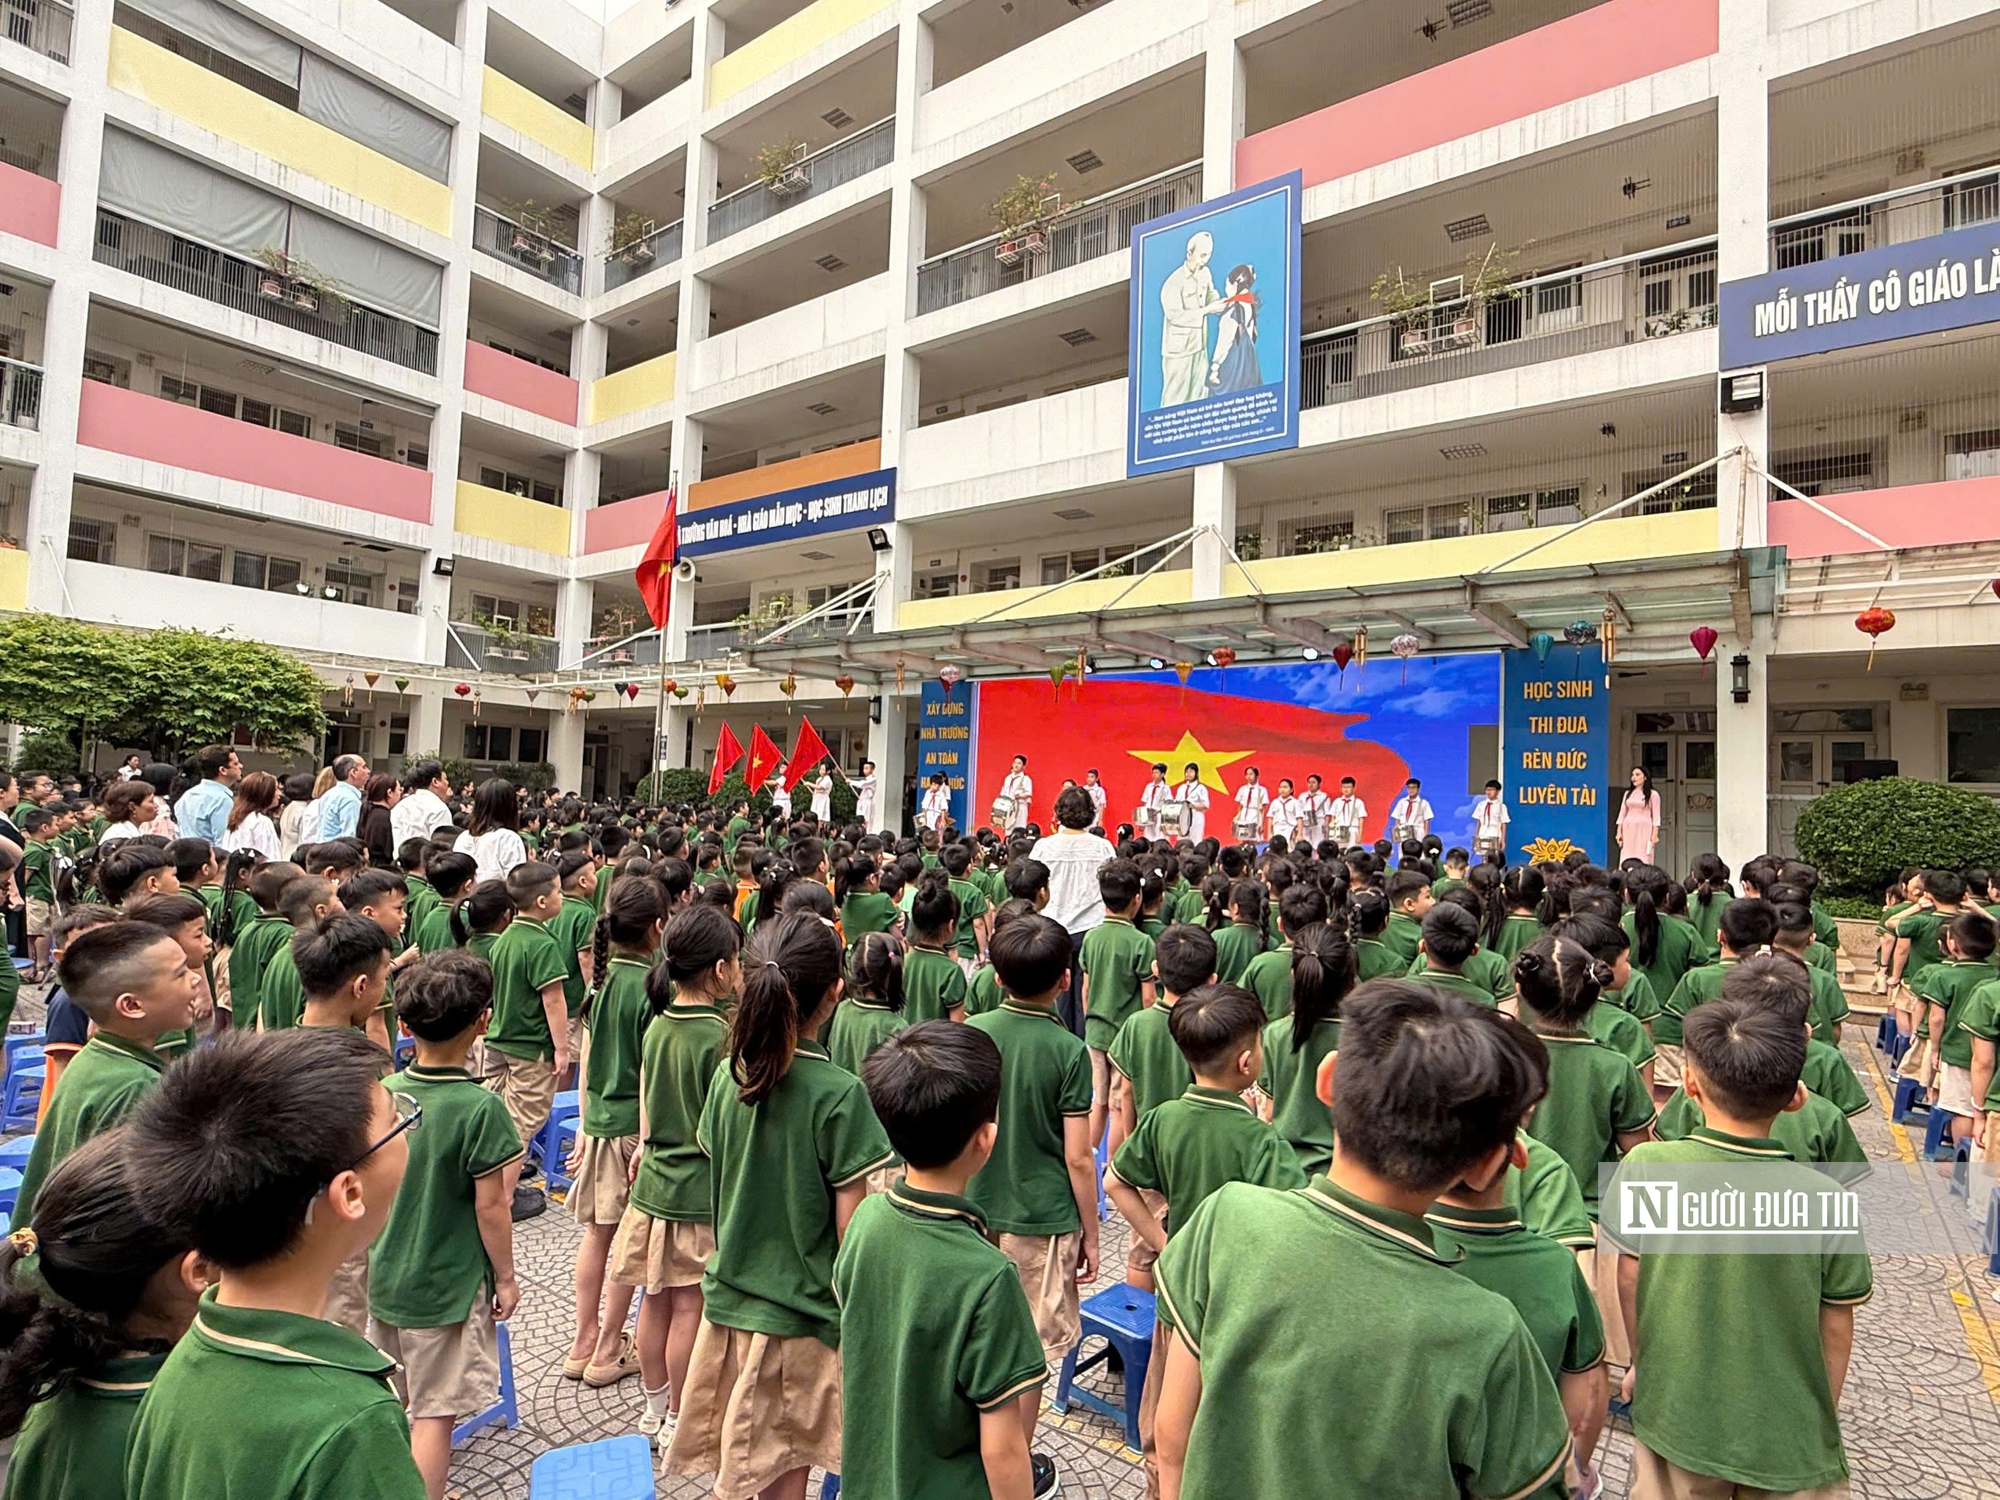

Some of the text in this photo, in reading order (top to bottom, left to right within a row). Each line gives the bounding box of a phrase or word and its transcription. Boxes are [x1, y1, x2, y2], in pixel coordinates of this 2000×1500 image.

[1755, 287, 1797, 337] MỖI
[1804, 276, 1861, 327] THẦY
[1868, 269, 1902, 315] CÔ
[1908, 259, 1968, 307] GIÁO
[752, 507, 768, 531] GIÁO
[808, 498, 823, 523] HỌC
[824, 495, 842, 517] SINH
[843, 490, 869, 514] THANH
[870, 485, 888, 511] LỊCH
[1523, 680, 1593, 702] HỌC SINH
[926, 700, 941, 716] XÂY
[921, 724, 969, 739] NHÀ TRƯỜNG
[1528, 716, 1588, 734] THI ĐUA
[925, 750, 958, 765] AN TOÀN
[1522, 748, 1587, 769] RÈN ĐỨC
[1570, 784, 1596, 806] TÀI
